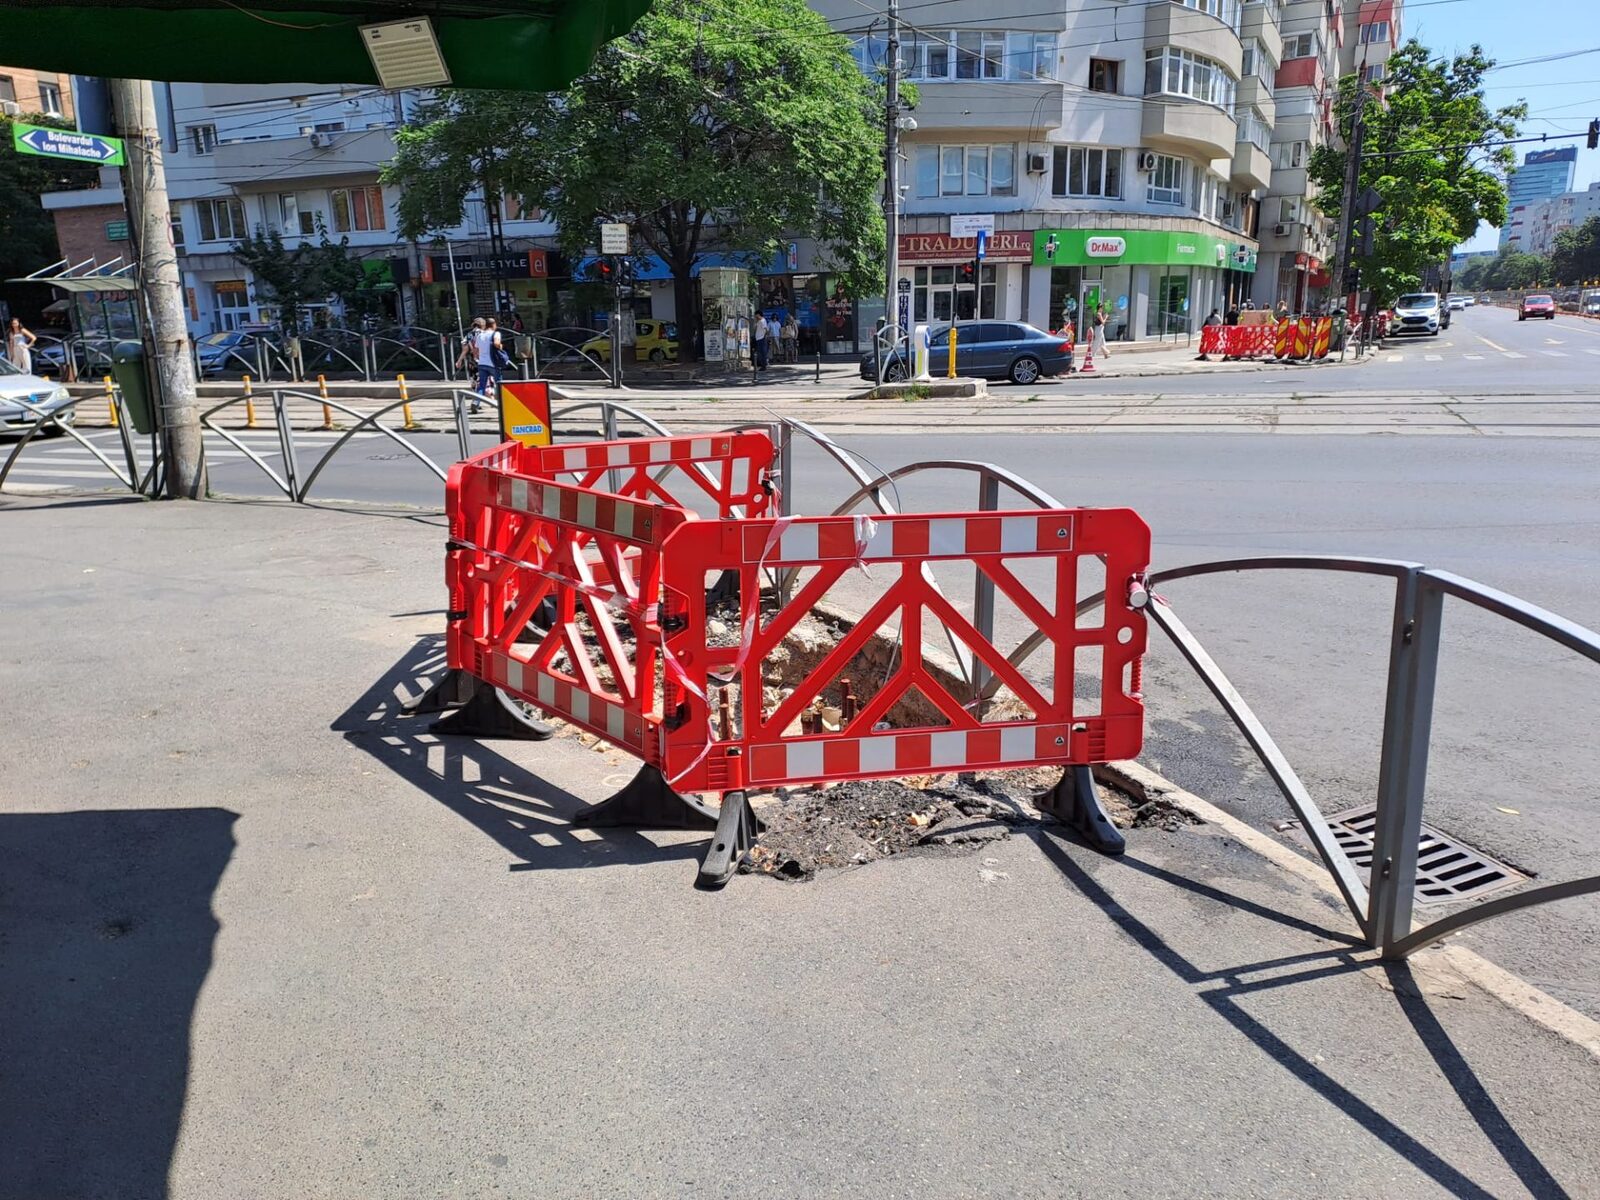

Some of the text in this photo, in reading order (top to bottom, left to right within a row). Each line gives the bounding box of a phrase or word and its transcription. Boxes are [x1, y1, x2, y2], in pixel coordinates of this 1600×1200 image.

[47, 131, 93, 146] Bulevardul
[42, 141, 101, 158] Ion Mihalache
[1091, 242, 1119, 252] Dr.Max
[512, 425, 542, 434] TANCRAD
